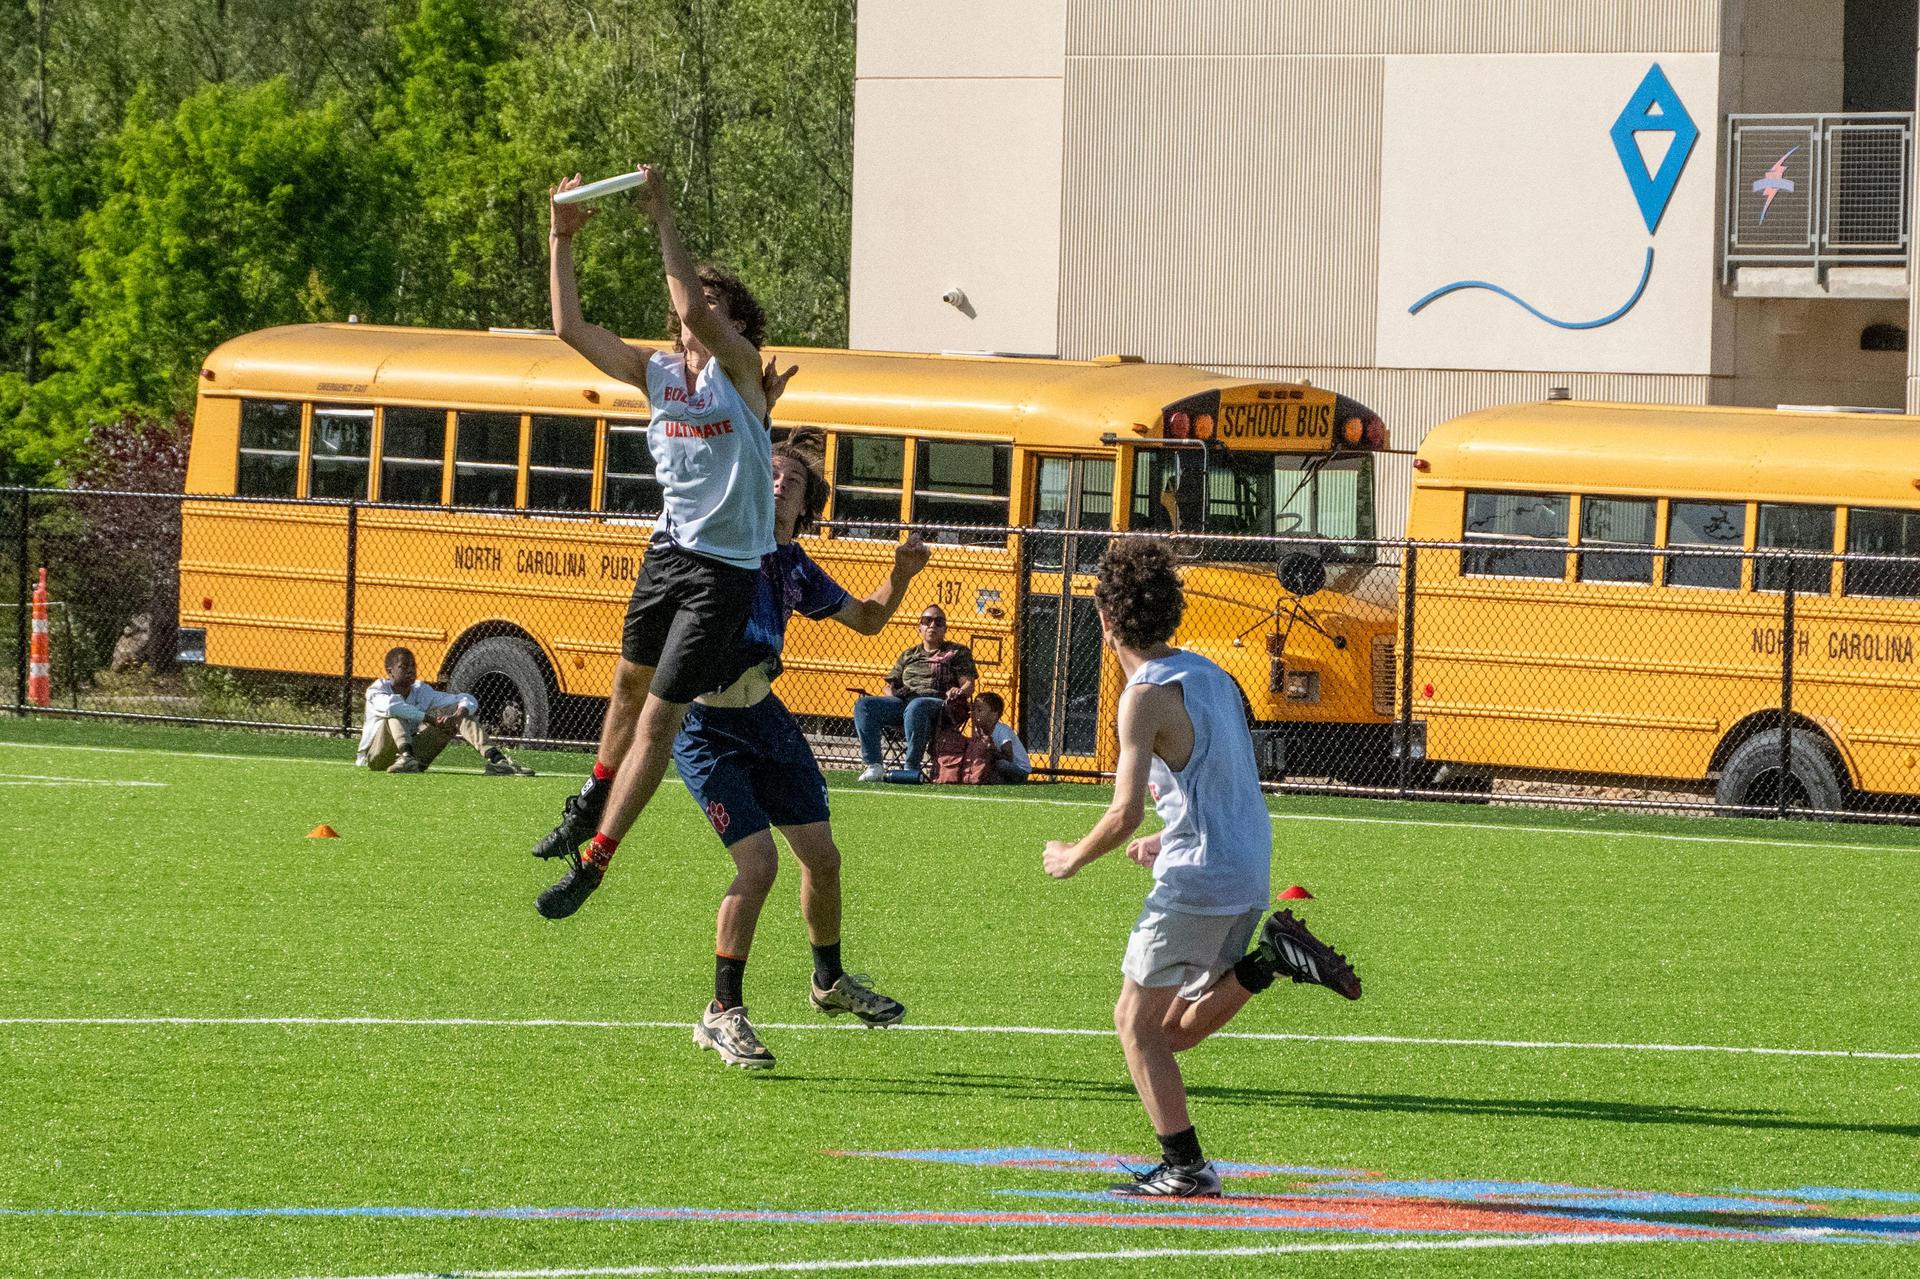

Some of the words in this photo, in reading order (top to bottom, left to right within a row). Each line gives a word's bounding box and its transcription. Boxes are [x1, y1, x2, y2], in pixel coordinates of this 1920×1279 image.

[665, 419, 733, 438] ULTIMATE
[1223, 403, 1290, 437] SCHOOL
[1296, 404, 1330, 437] BUS
[455, 546, 501, 571] NORTH
[516, 549, 587, 577] CAROLINA
[937, 580, 961, 605] 137
[1828, 631, 1914, 663] CAROLINA
